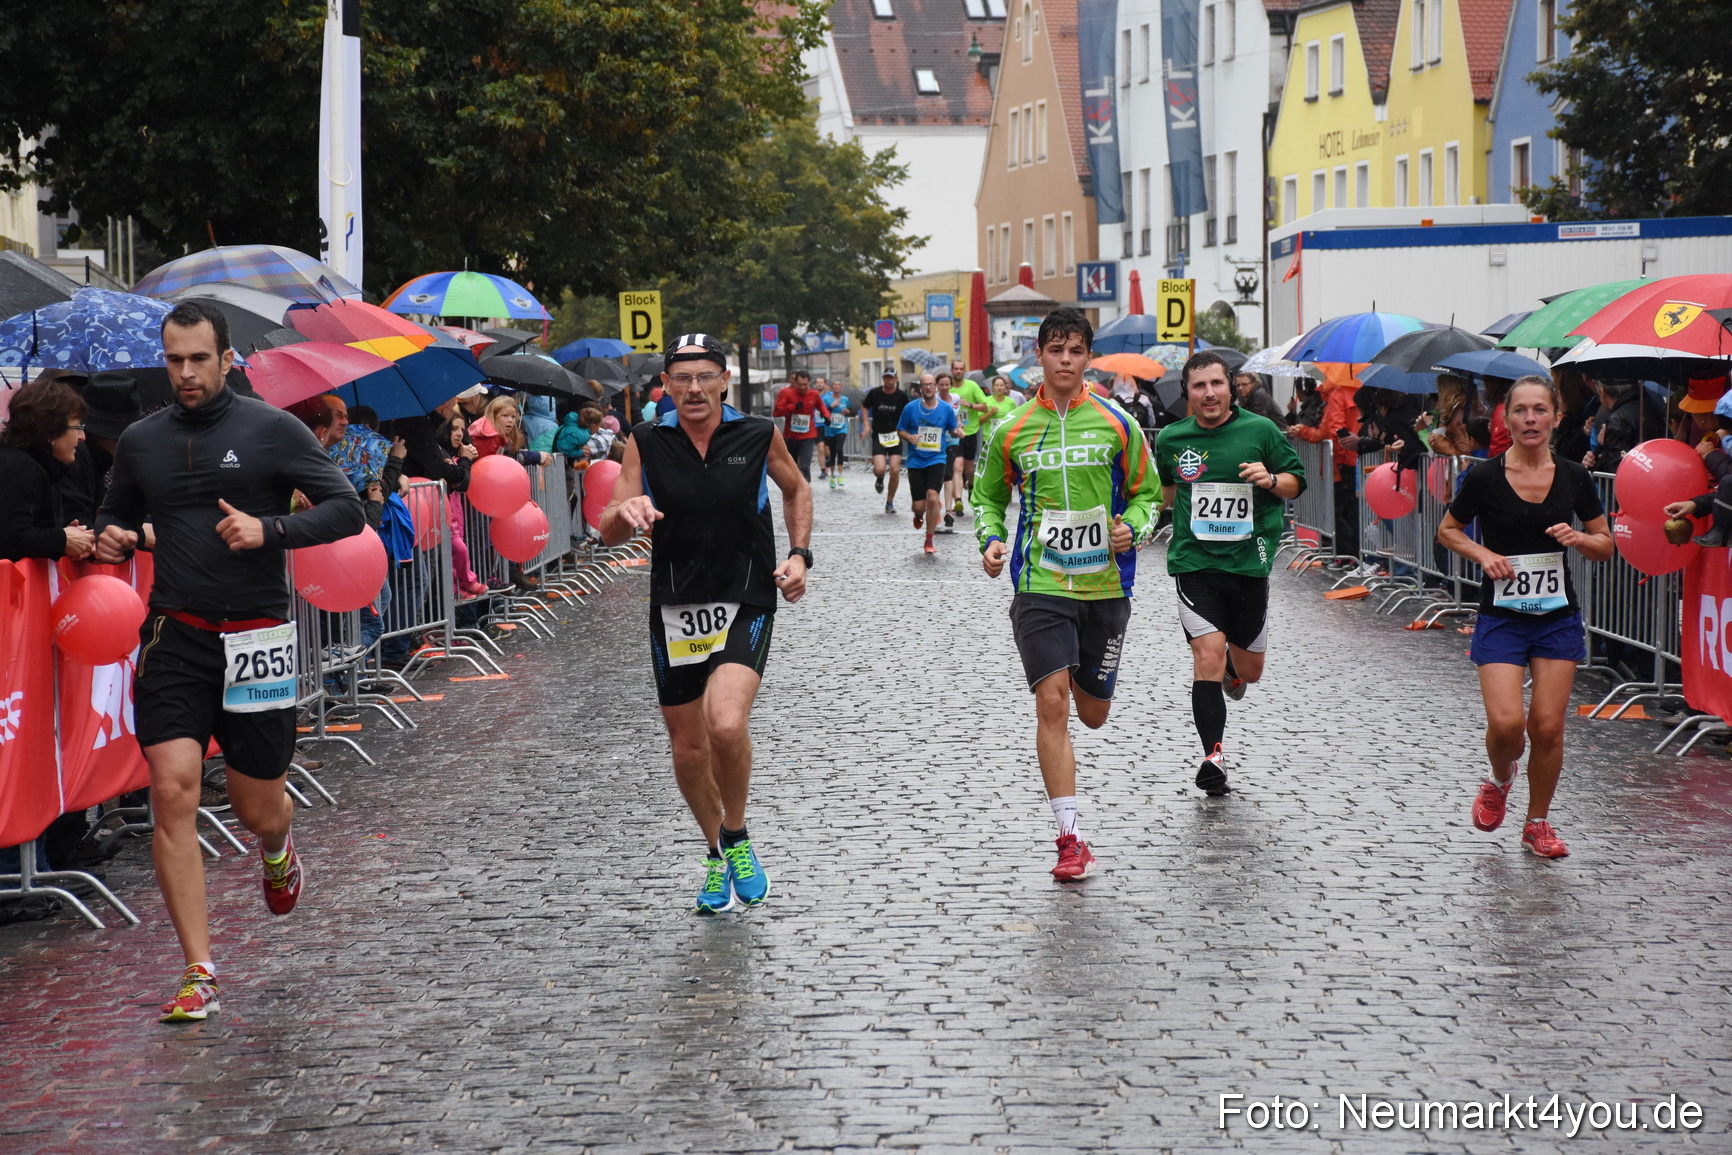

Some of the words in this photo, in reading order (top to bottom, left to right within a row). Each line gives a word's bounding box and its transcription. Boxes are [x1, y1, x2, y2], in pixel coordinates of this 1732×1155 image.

[1085, 75, 1113, 145] K&L
[1319, 130, 1345, 159] HOTEL
[624, 294, 656, 306] Block
[1162, 281, 1191, 293] Block
[631, 310, 652, 340] D
[1167, 298, 1186, 328] D
[1018, 445, 1112, 473] BOCK
[1198, 496, 1249, 519] 2479
[1046, 522, 1102, 551] 2870
[1208, 523, 1236, 533] Rainer
[1257, 536, 1268, 565] Geek
[1525, 555, 1558, 565] BOCK
[1502, 569, 1559, 597] 2875
[1521, 601, 1542, 612] Rosi
[680, 606, 728, 637] 308
[234, 644, 293, 684] 2653
[247, 686, 290, 700] Thomas
